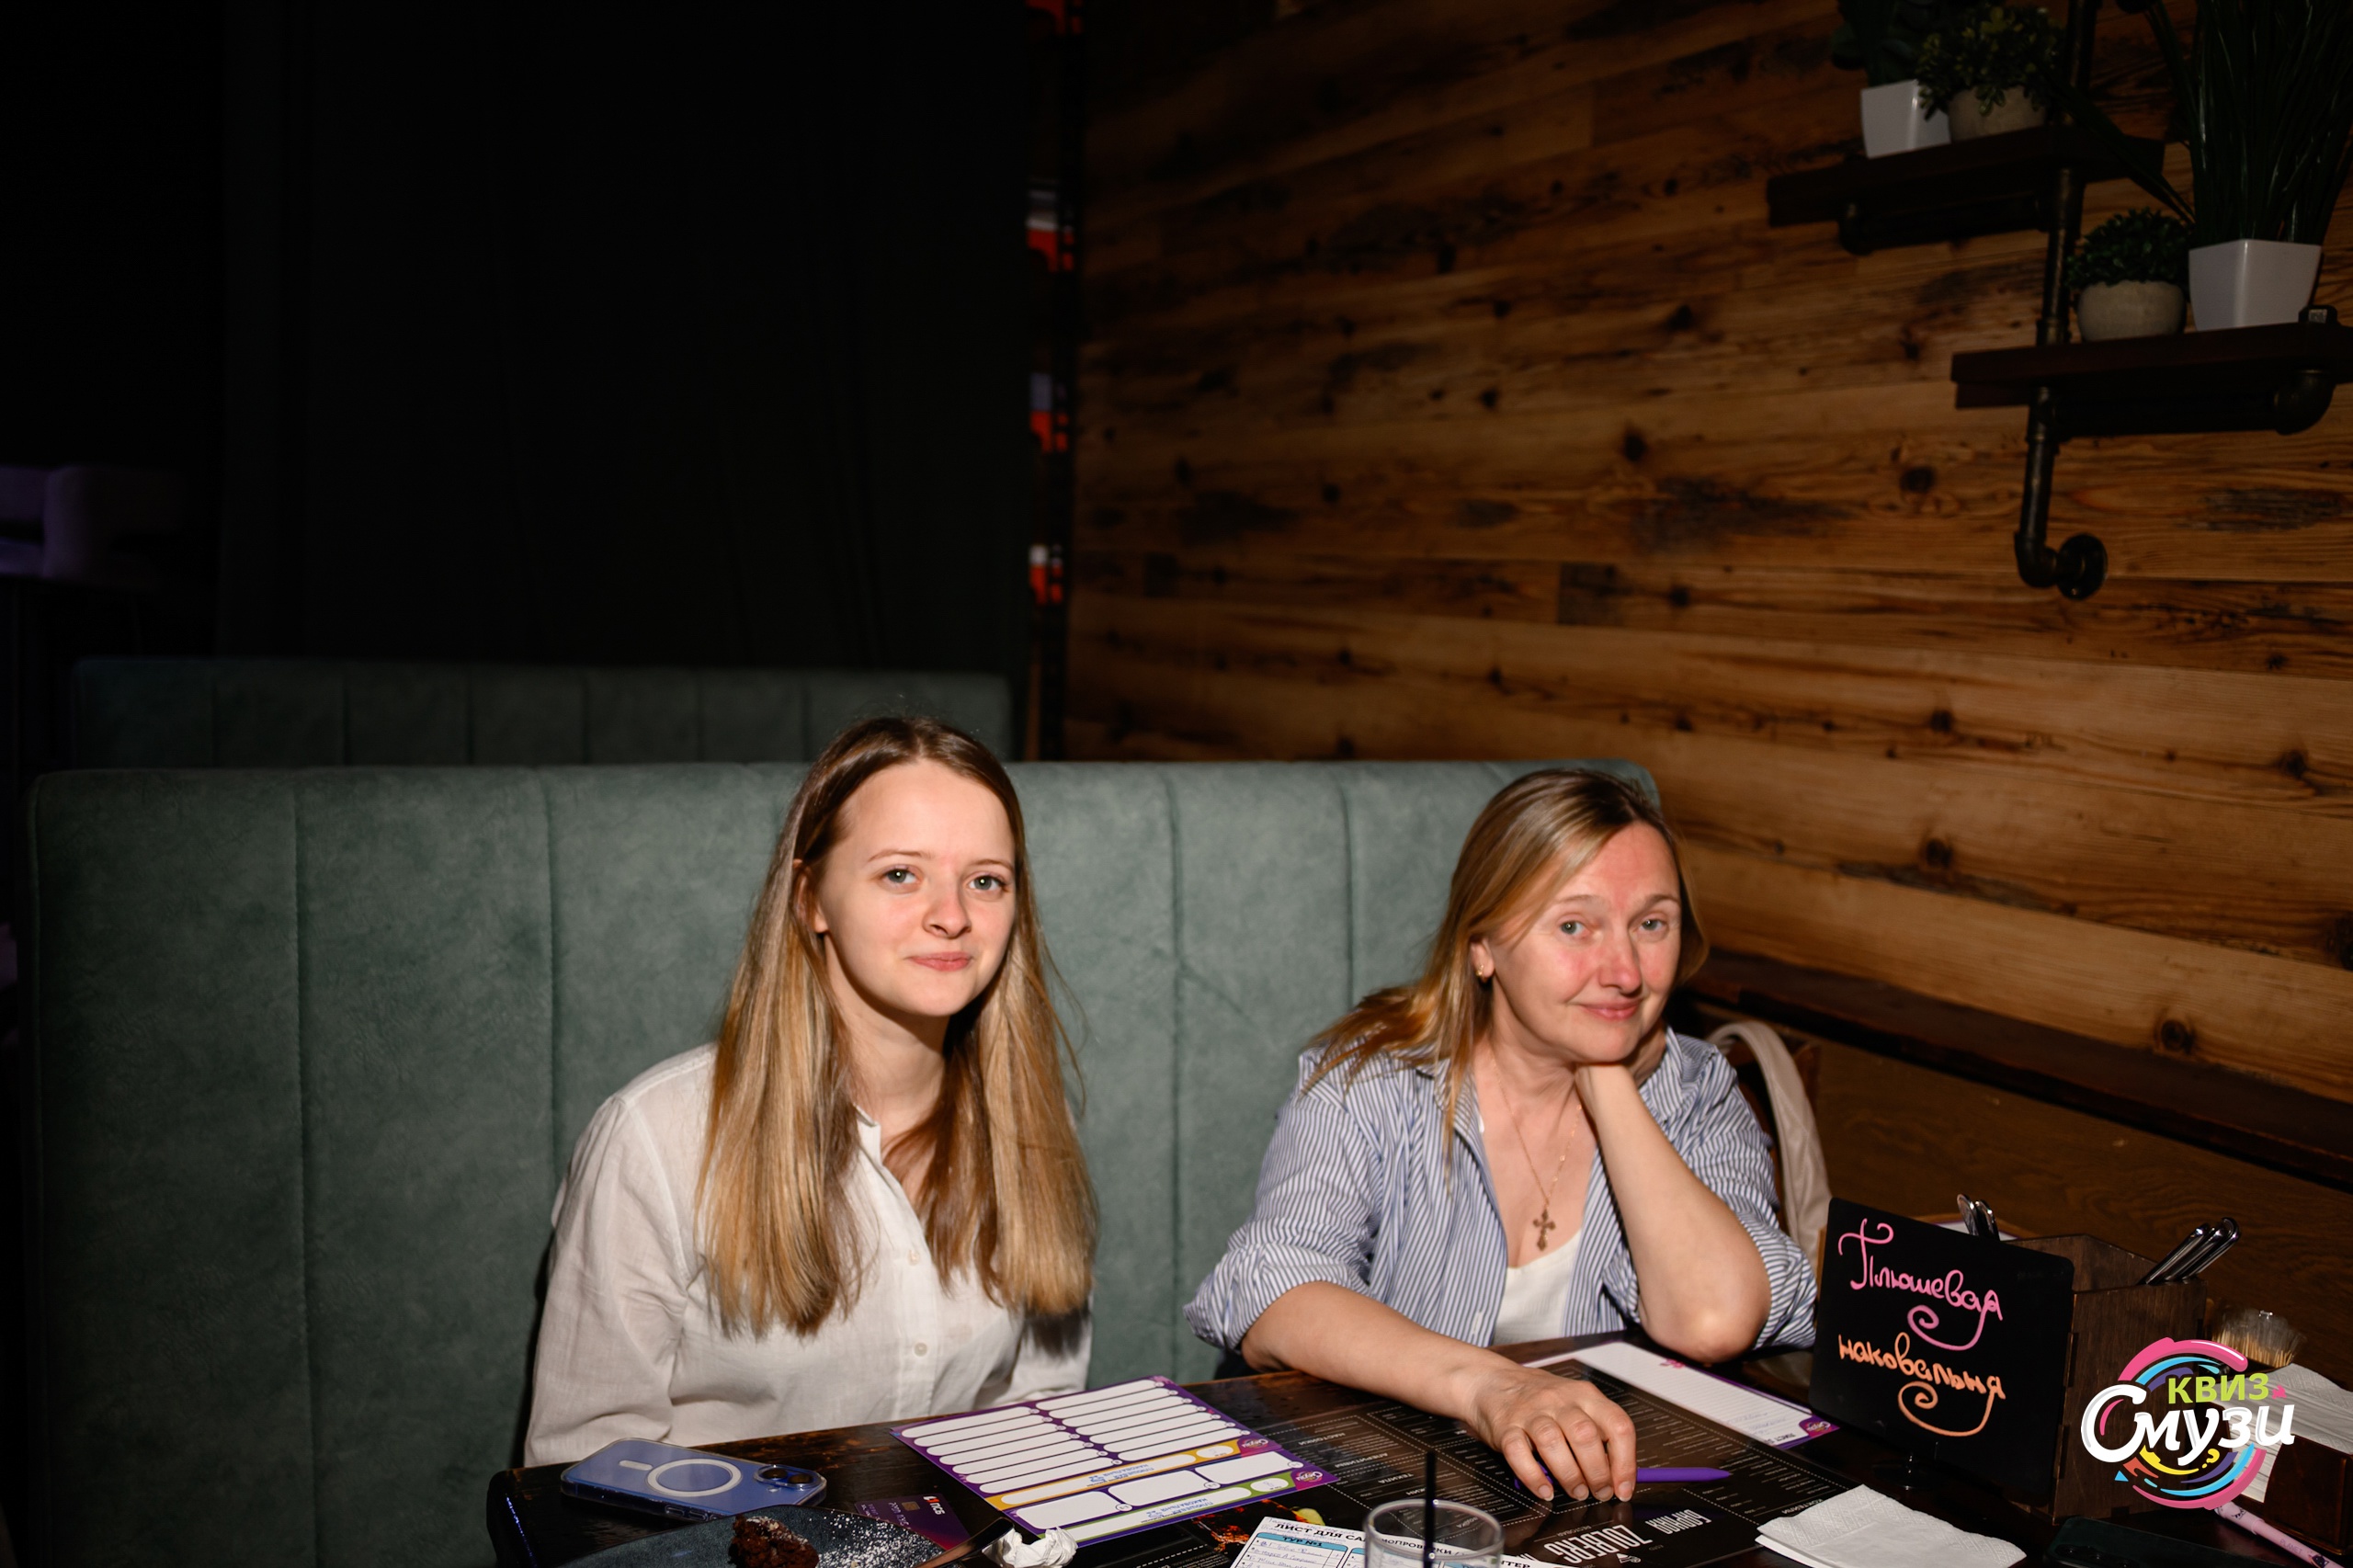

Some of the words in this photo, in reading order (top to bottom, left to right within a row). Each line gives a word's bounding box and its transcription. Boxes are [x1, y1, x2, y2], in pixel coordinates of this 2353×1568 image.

[1837, 1218, 2004, 1351] Плюшевая
[1838, 1332, 2006, 1437] наковальня
[1298, 1432, 1346, 1446] НАСТОЙКИ
[1334, 1452, 1389, 1468] АПЕРИТИВЫ
[1378, 1472, 1415, 1484] ТЕКИЛА
[929, 1502, 946, 1516] ПСБ
[1645, 1509, 1712, 1535] БАРНАЯ
[1275, 1523, 1313, 1534] ЛИСТ
[1314, 1529, 1343, 1539] ДЛЯ
[1282, 1536, 1303, 1544] ТУР
[1543, 1524, 1654, 1564] ZOLBERG
[2279, 1538, 2302, 1555] PLANET
